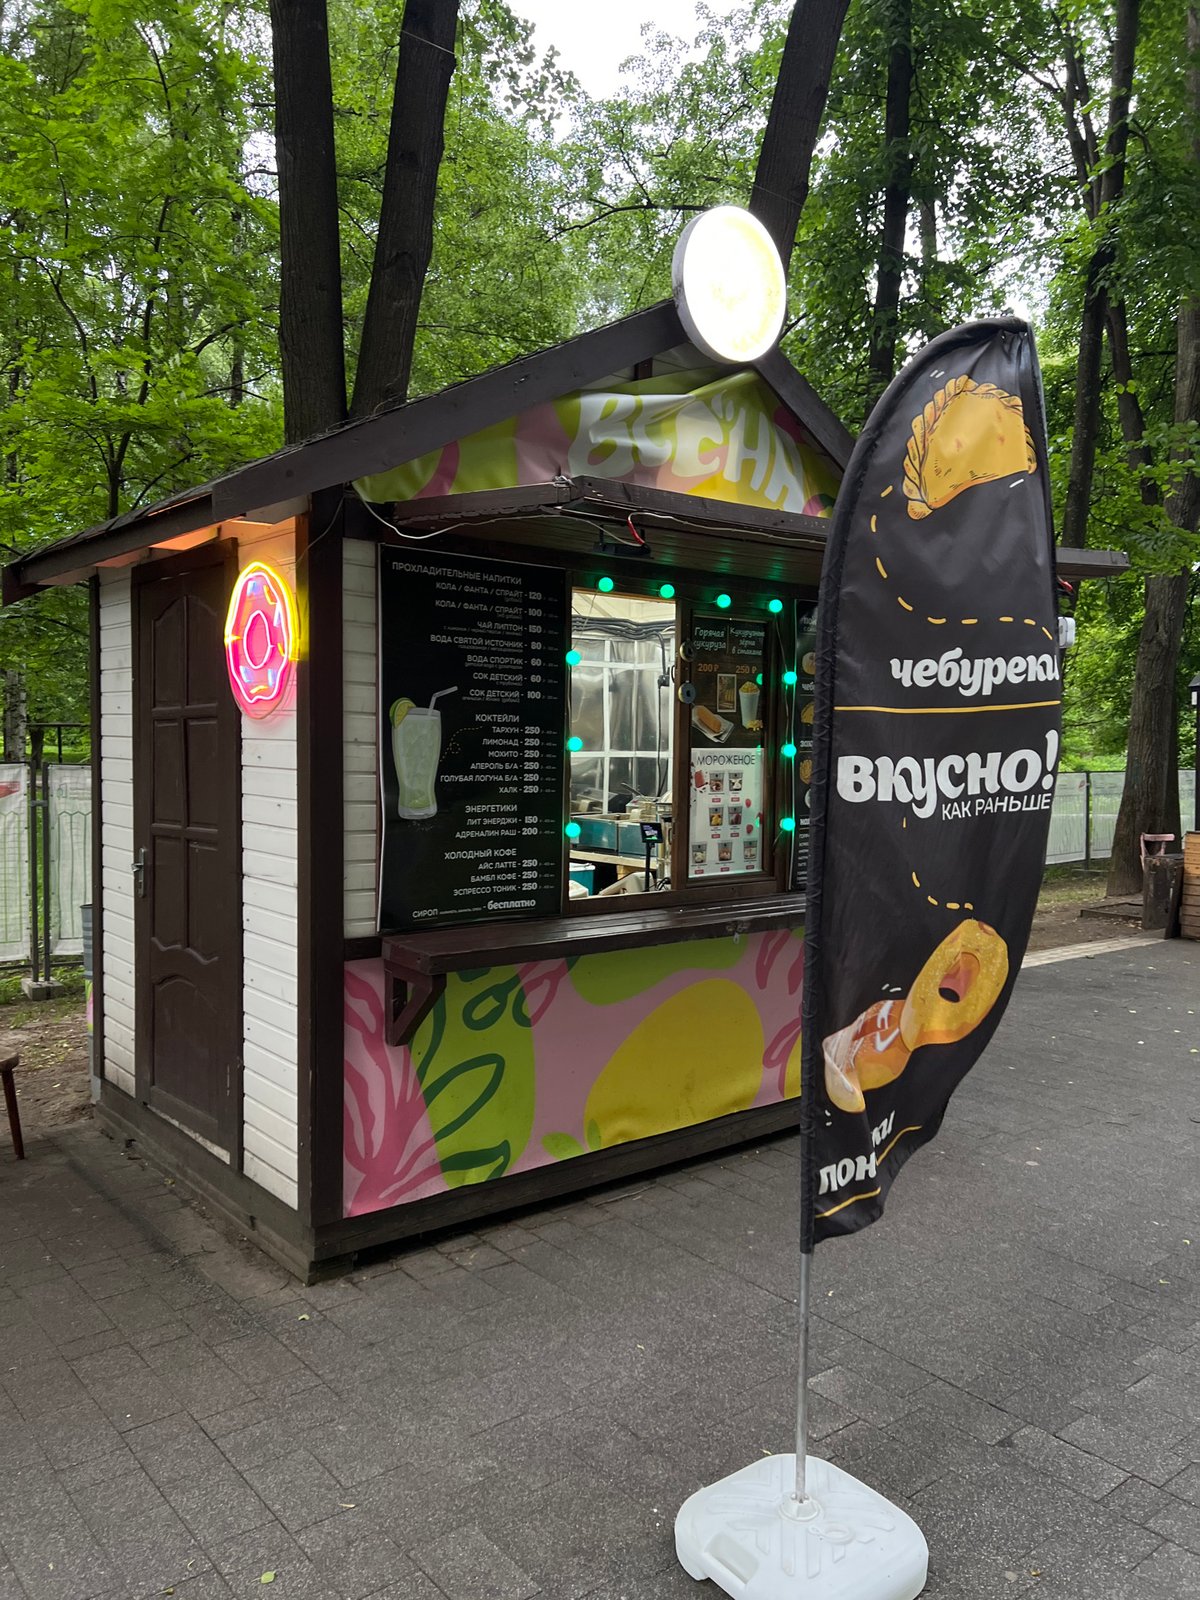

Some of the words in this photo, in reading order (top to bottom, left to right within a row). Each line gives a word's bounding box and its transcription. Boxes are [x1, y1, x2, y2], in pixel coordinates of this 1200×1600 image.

[392, 562, 481, 580] ПРОХЛАДИТЕЛЬНЫЕ
[483, 574, 522, 585] НАПИТКИ
[436, 582, 456, 590] КОЛА
[464, 586, 489, 594] ФАНТА
[495, 588, 523, 598] СПРАЙТ
[529, 592, 542, 600] 120
[435, 600, 456, 608] КОЛА
[463, 603, 488, 611] ФАНТА
[495, 605, 523, 614] СПРАЙТ
[528, 609, 542, 617] 100
[477, 621, 493, 629] ЧАЙ
[494, 623, 523, 631] ЛИПТОН
[528, 625, 542, 633] 150
[430, 634, 452, 644] ВОДА
[453, 636, 483, 645] СВЯТОЙ
[484, 639, 523, 648] ИСТОЧНИК
[531, 641, 542, 650] 80
[467, 655, 488, 663] ВОДА
[489, 656, 523, 665] СПОРТИК
[890, 647, 1059, 696] чебуреки
[489, 673, 523, 682] ДЕТСКИЙ
[530, 675, 542, 683] 60
[486, 690, 520, 698] ДЕТСКИЙ
[527, 691, 541, 699] 100
[475, 714, 519, 722] КОКТЕЙЛИ
[697, 755, 756, 766] МОРОЖЕНОЕ
[465, 804, 517, 813] ЭНЕРГЕТИКИ
[942, 801, 971, 820] КАК
[975, 793, 1052, 816] РАНЬШЕ
[455, 830, 499, 839] АДРЕНАЛИН
[444, 849, 492, 860] ХОЛОДНЫЙ
[494, 848, 517, 857] КОФЕ
[522, 859, 538, 867] 250
[453, 886, 491, 896] ЭСПРЕССО
[522, 882, 538, 890] 250
[412, 909, 438, 918] СИРОП
[487, 899, 536, 910] бесплатно
